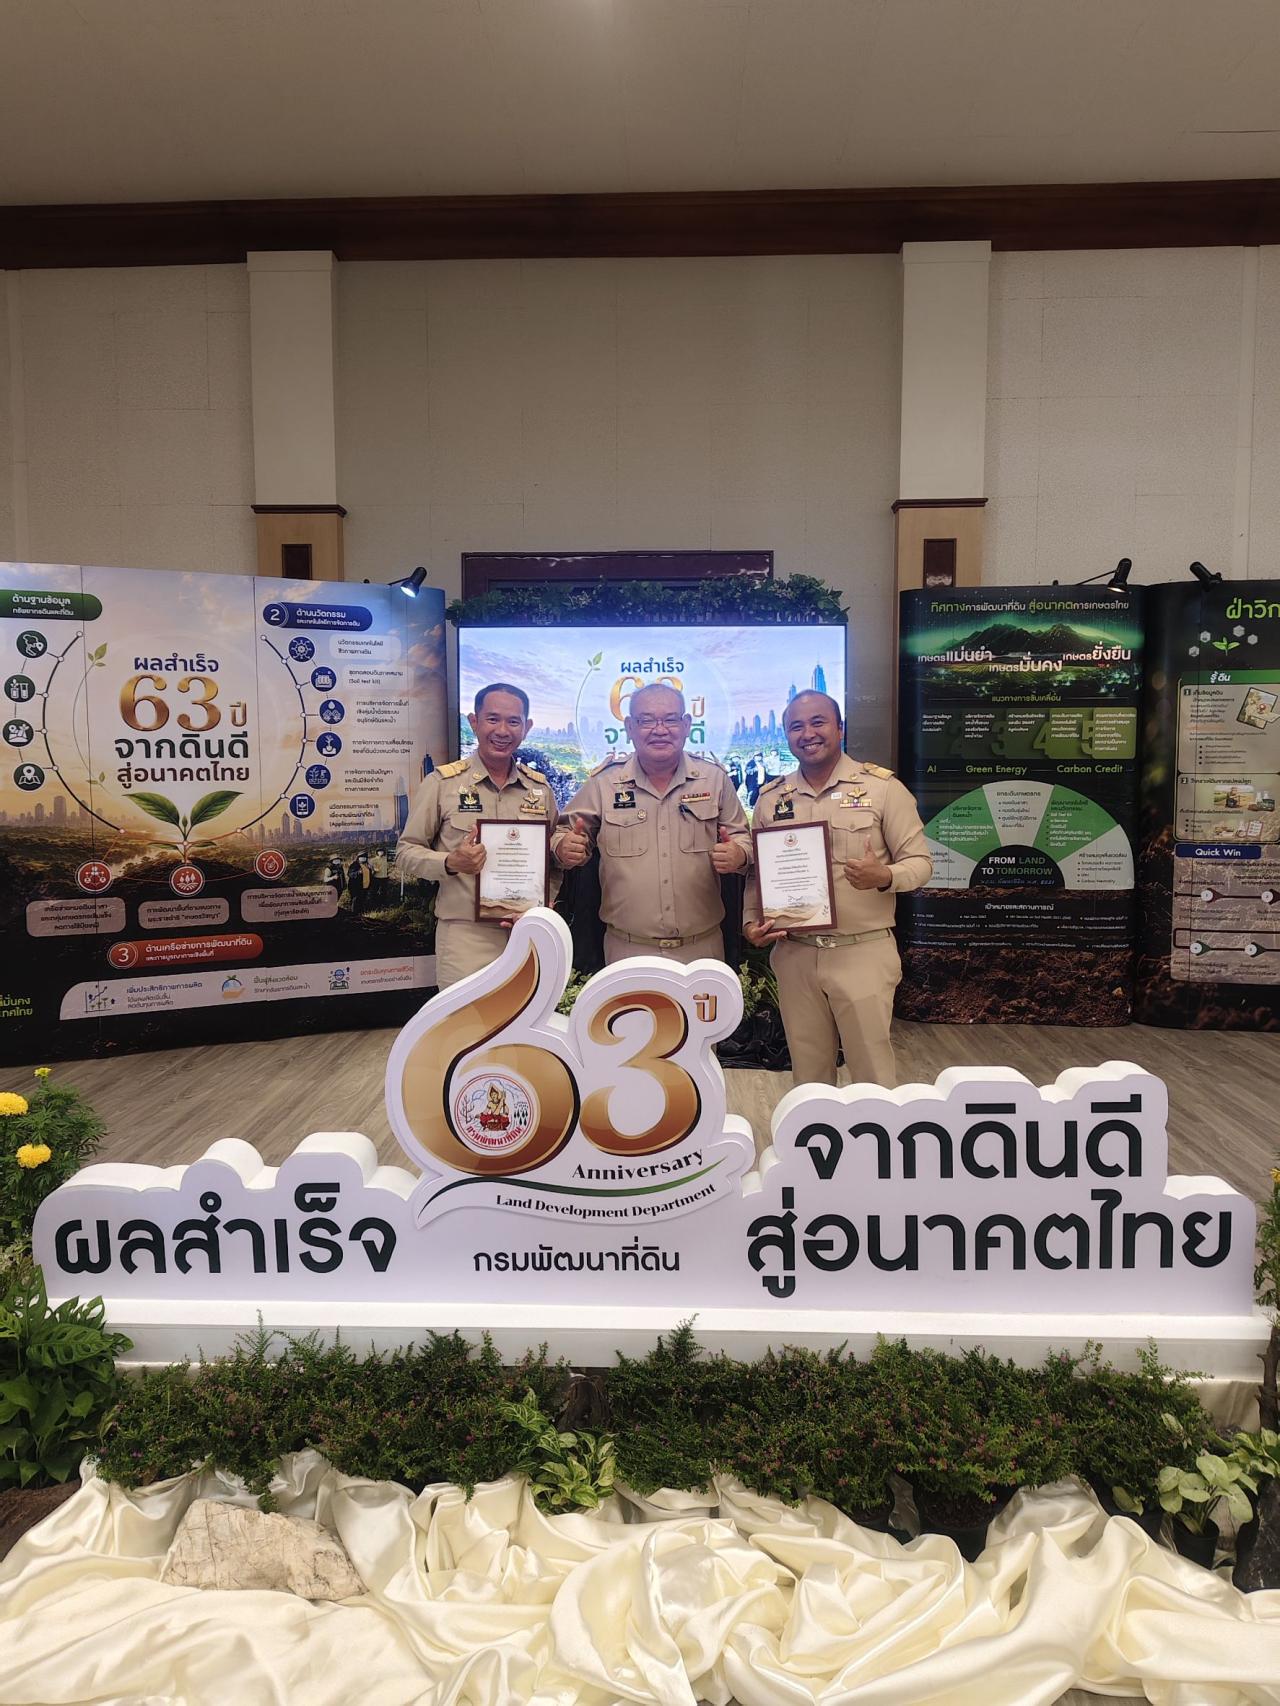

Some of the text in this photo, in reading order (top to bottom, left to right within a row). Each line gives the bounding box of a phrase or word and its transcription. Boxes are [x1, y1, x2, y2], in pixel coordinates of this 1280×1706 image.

[12, 593, 71, 607] ด้านฐานข้อมูล
[931, 599, 1129, 614] ทิศทางการพัฒนาที่ดิน สู่อนาคตการเกษตรไทย
[270, 609, 280, 621] 2
[296, 608, 346, 618] ด้านนวัตกรรม
[918, 645, 993, 663] เกษตรแม่นยำ
[1063, 641, 1131, 661] เกษตรยั่งยืน
[134, 653, 219, 672] ผลสำเร็จ
[621, 657, 685, 673] ผลสำเร็จ
[989, 651, 1063, 673] เกษตรมั่นคง
[119, 674, 247, 732] 63 ปี
[691, 696, 705, 718] ปี
[114, 731, 249, 759] จากดินดี
[117, 761, 250, 789] สู่อนาคตไทย
[927, 765, 937, 774] AI
[965, 765, 1028, 776] Green Energy
[1056, 765, 1123, 774] Carbon Credit
[988, 856, 1046, 865] FROM LAND
[1195, 848, 1241, 857] Quick Win
[981, 867, 1053, 875] TO TOMORROW
[145, 936, 253, 953] ด้านเครือข่ายการพัฒนาที่ดิน
[118, 948, 130, 962] 3
[401, 938, 718, 1177] 63 ปี
[795, 1093, 1143, 1181] จากดินดี
[571, 1148, 705, 1181] Anniversary
[496, 1183, 717, 1219] Land Development Department
[54, 1182, 398, 1275] ผลสำเร็จ
[746, 1186, 1233, 1299] สู่อนาคตไทย
[473, 1235, 681, 1273] กรมพัฒนาที่ดิน
